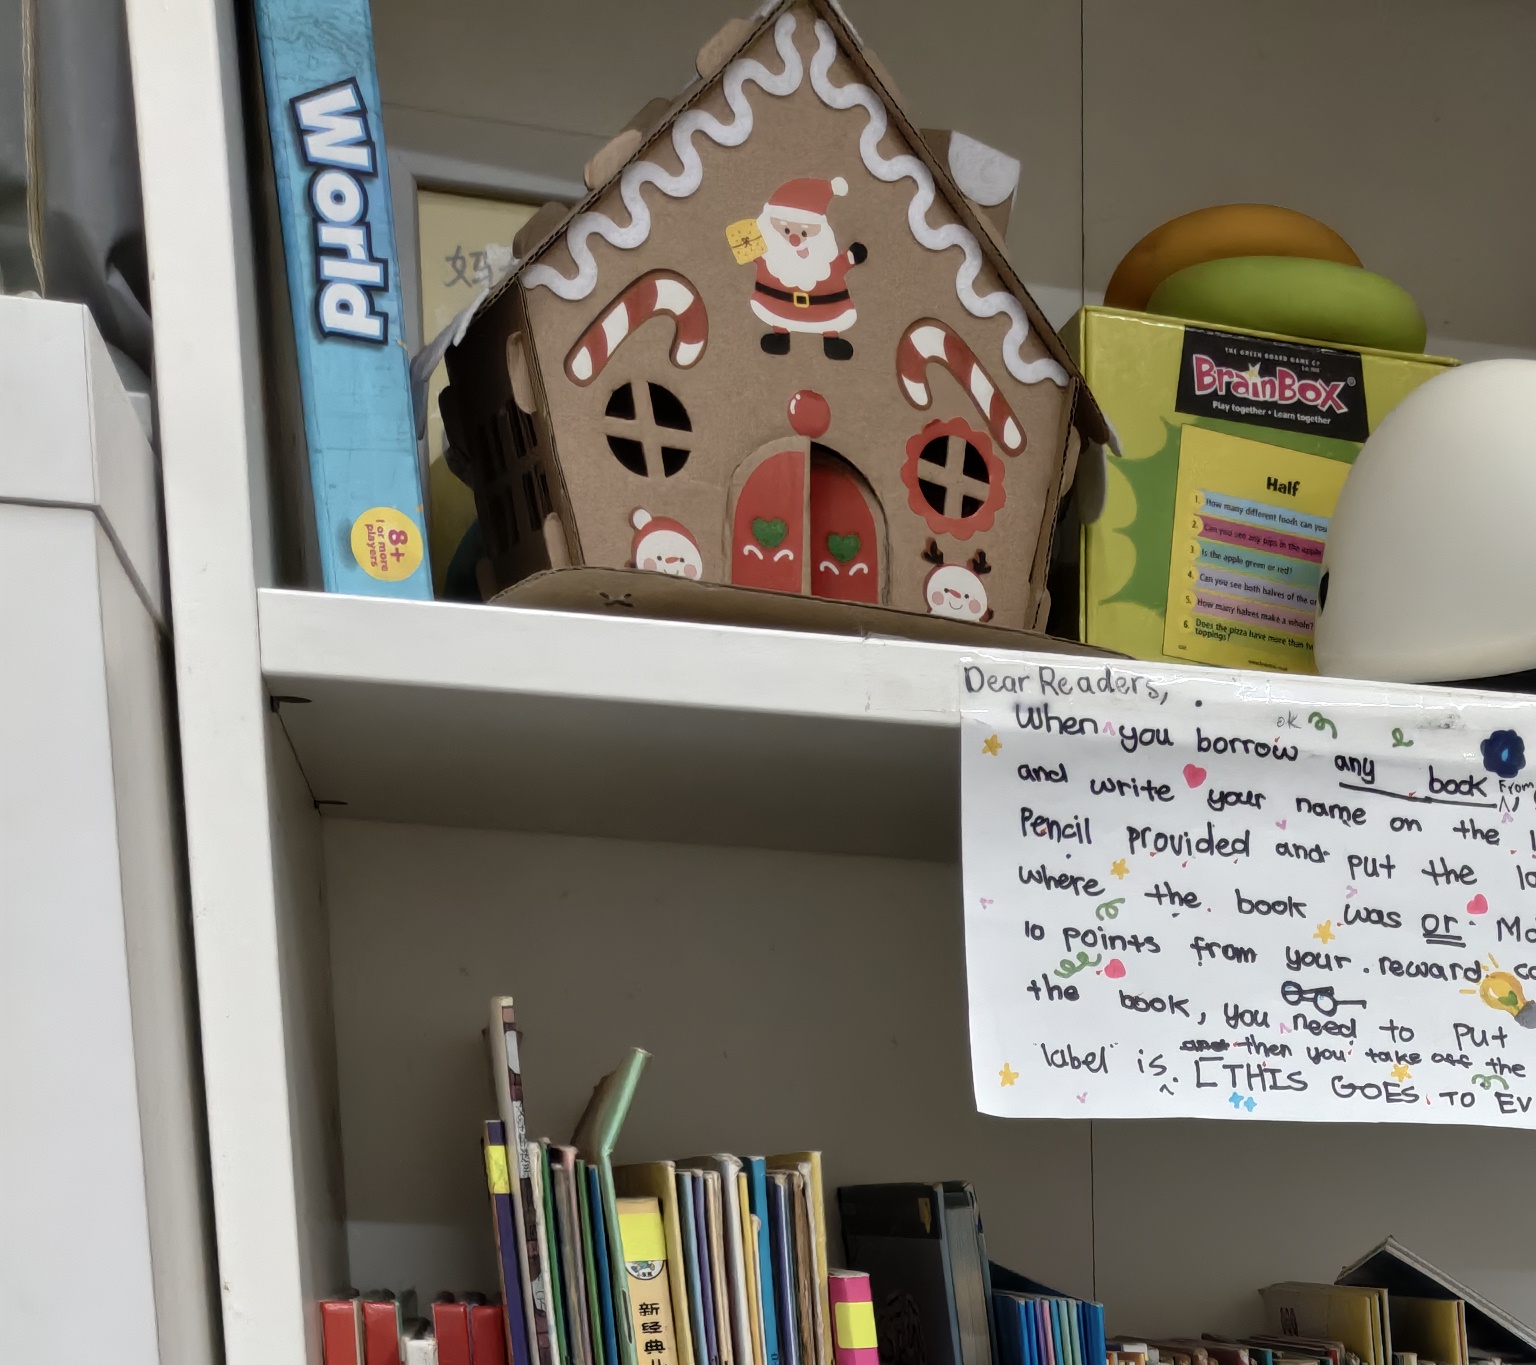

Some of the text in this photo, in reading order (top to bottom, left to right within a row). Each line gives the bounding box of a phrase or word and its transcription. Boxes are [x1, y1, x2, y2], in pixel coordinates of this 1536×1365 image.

[292, 78, 388, 346] World
[1193, 354, 1348, 414] BrainBox
[1213, 400, 1331, 425] Play together Learn together
[1267, 476, 1300, 496] Half
[964, 666, 1169, 705] Dear Readers,
[1014, 704, 1098, 735] When
[1118, 723, 1174, 753] you
[1196, 728, 1298, 762] borrow
[1335, 753, 1375, 784] any
[1428, 765, 1487, 796] book
[1018, 764, 1068, 784] and
[1090, 775, 1175, 802] write
[1208, 787, 1266, 811] your
[1295, 797, 1367, 826] name
[1390, 815, 1423, 832] on
[1453, 822, 1500, 846] the
[1127, 823, 1250, 859] provided
[1275, 839, 1327, 863] and
[1422, 858, 1477, 886] the
[1019, 867, 1105, 898] where
[1144, 882, 1199, 909] the
[1236, 889, 1307, 917] book
[1344, 904, 1401, 928] was
[1421, 913, 1458, 934] or
[1025, 921, 1045, 941] 10
[1063, 926, 1161, 959] points
[1190, 937, 1258, 966] from
[1285, 946, 1352, 972] your
[1380, 954, 1483, 983] reward
[1026, 976, 1080, 1002] the
[1119, 992, 1207, 1026] book,
[1223, 1002, 1270, 1028] you
[1292, 1013, 1357, 1040] need
[1380, 1019, 1415, 1042] to
[1331, 1074, 1419, 1104] GOES
[1440, 1090, 1475, 1108] TO
